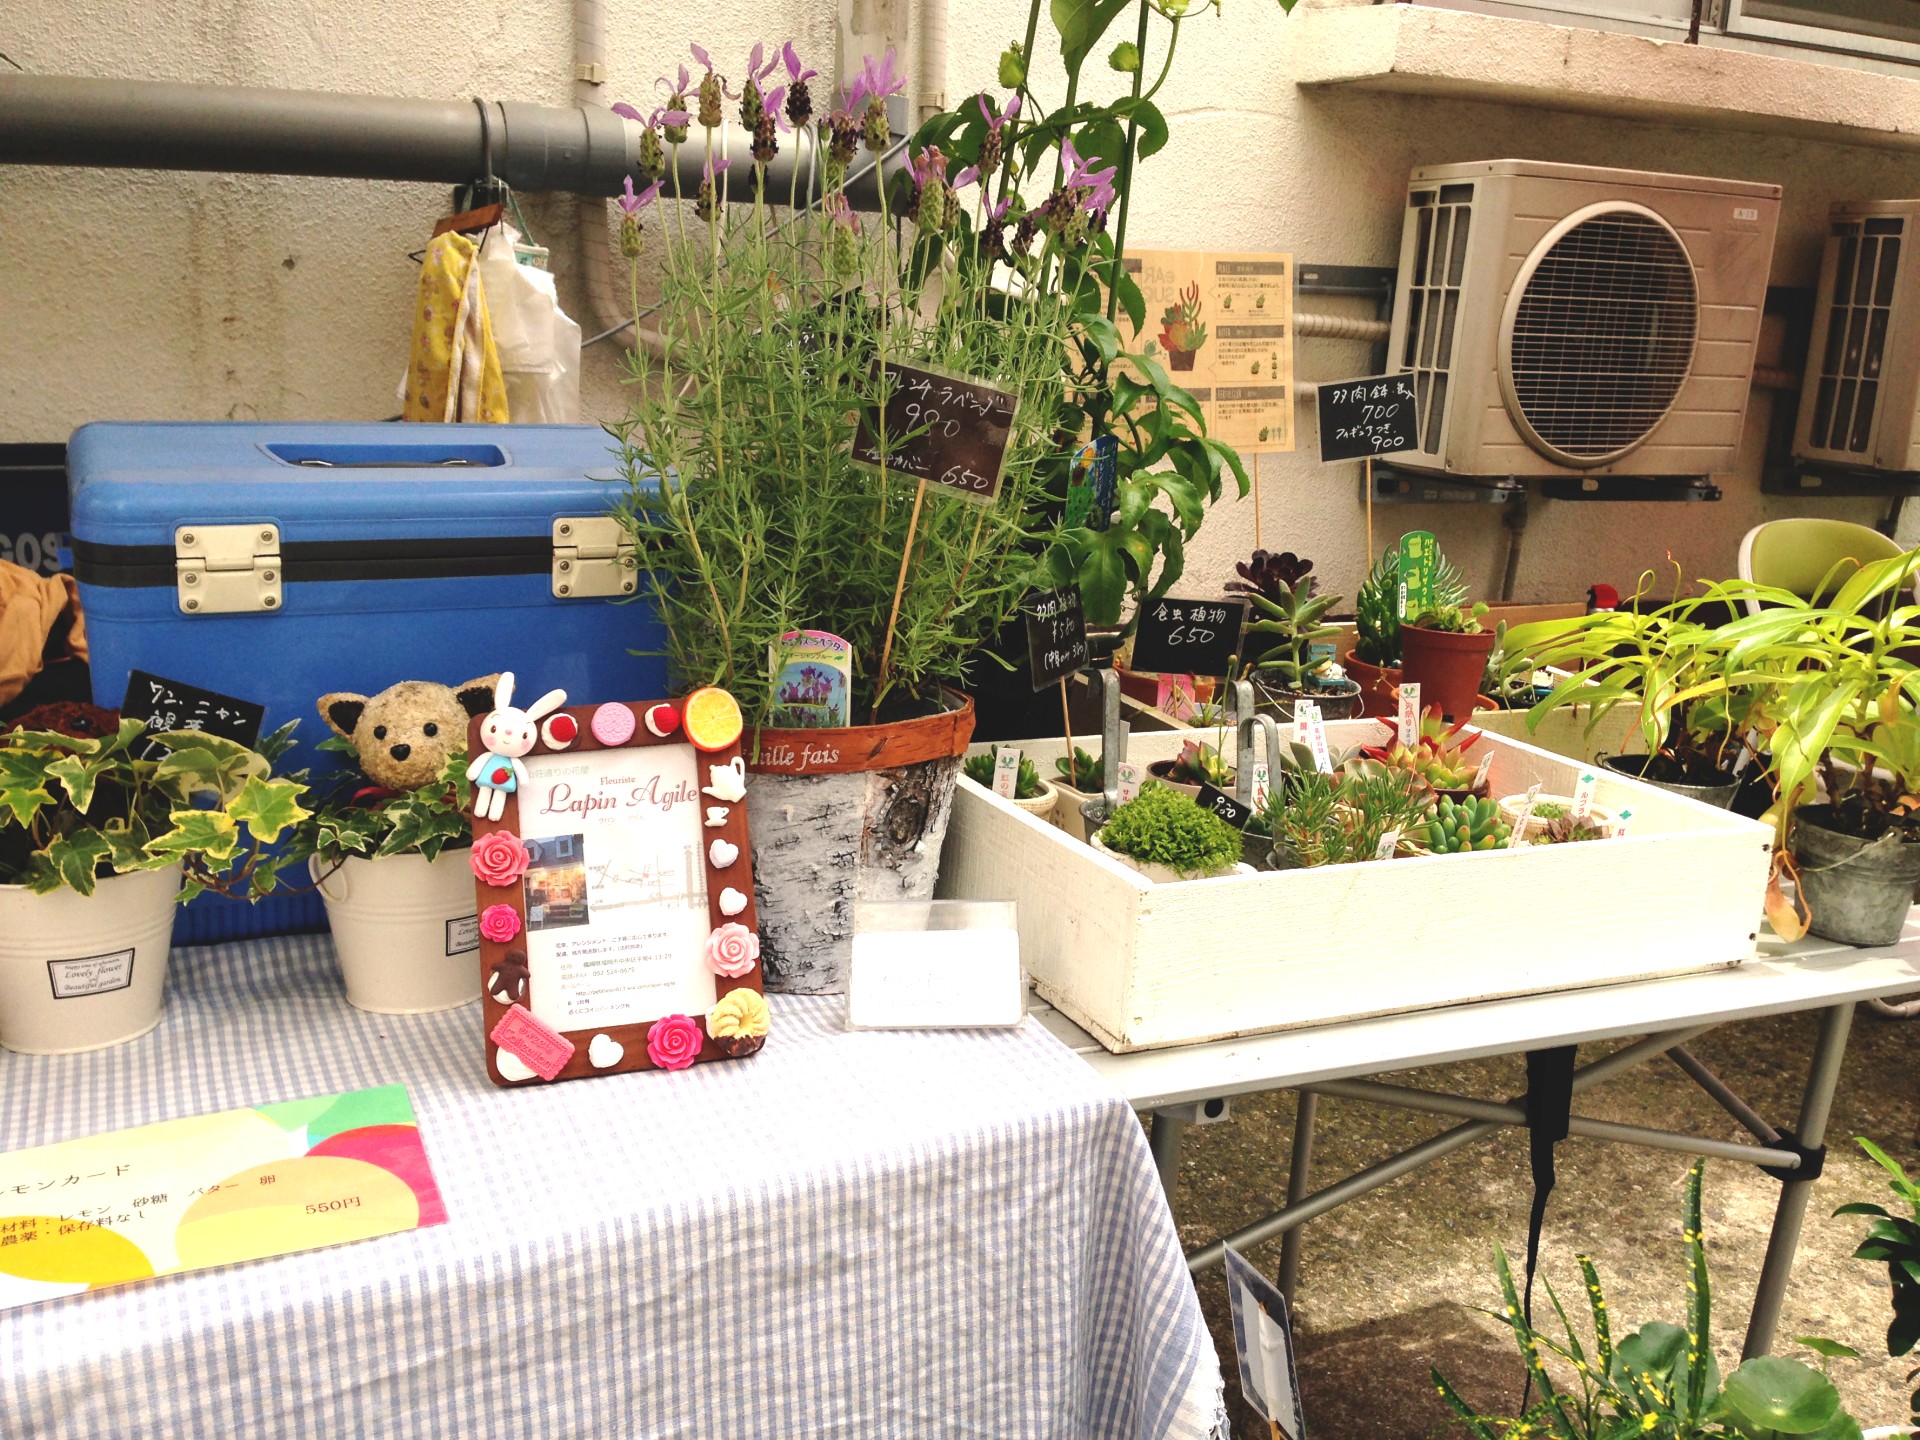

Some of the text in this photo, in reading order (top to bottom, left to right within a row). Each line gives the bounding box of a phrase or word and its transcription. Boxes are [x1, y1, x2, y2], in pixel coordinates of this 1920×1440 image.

[1361, 403, 1400, 425] 700
[1371, 435, 1404, 452] 900
[941, 465, 988, 489] 650
[1168, 626, 1215, 646] 650
[795, 742, 840, 771] fais
[600, 776, 636, 786] Fleuriste
[540, 775, 698, 819] Lapin Agile
[65, 963, 123, 979] Lovely flower
[64, 980, 97, 991] Beautiful
[0, 1164, 131, 1195] モンカード
[132, 1193, 168, 1209] 砂糖
[188, 1183, 239, 1198] バター
[258, 1174, 276, 1186] 卵
[305, 1196, 362, 1216] 550円
